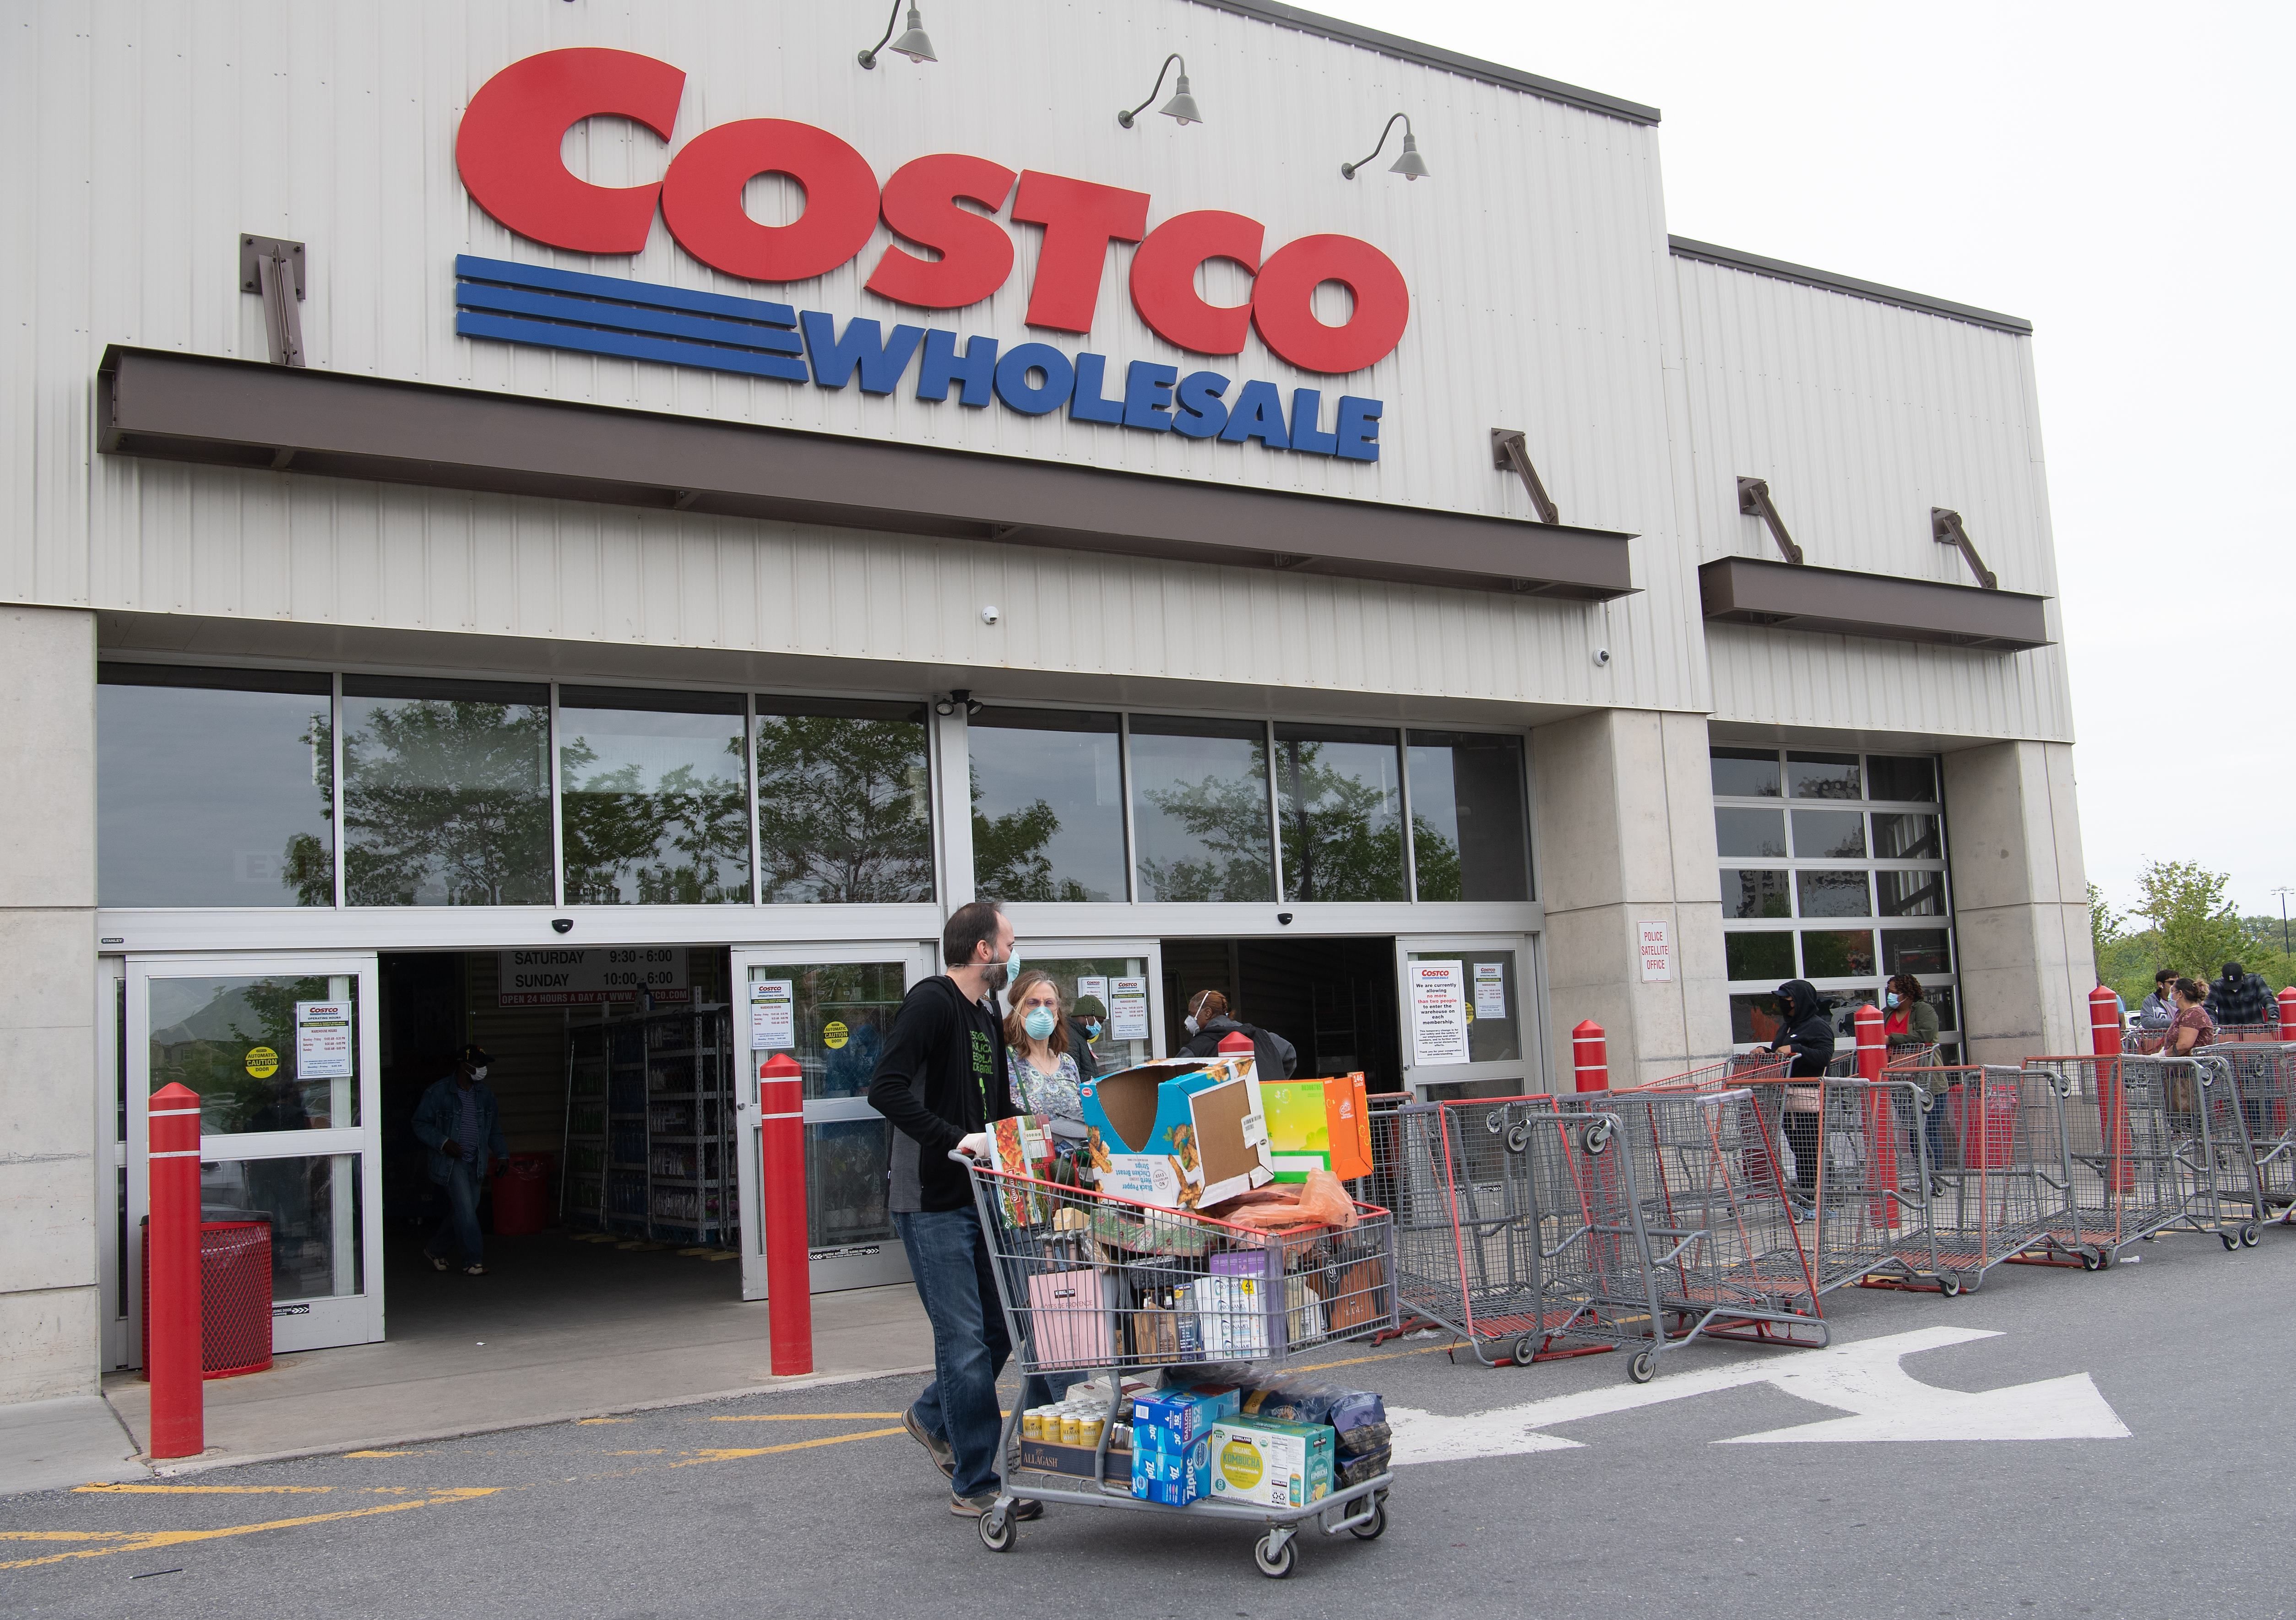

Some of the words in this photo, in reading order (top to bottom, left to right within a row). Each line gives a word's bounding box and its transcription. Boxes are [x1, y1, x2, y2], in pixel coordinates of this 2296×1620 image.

[455, 47, 1410, 374] COSTCO
[800, 310, 1384, 462] WHOLESALE
[1645, 932, 1663, 941] POLICE
[1641, 946, 1668, 955] SATELLITE
[515, 951, 585, 965] SATURDAY
[610, 950, 636, 963] 9:30
[646, 950, 672, 962] 6:00
[1647, 960, 1665, 970] OFFICE
[515, 974, 570, 988] SUNDAY
[603, 972, 637, 986] 10:00
[647, 971, 673, 984] 6:00
[502, 995, 524, 1004] OPEN
[527, 995, 537, 1003] 24
[540, 994, 567, 1002] HOURS
[579, 993, 594, 1002] DAY
[597, 992, 607, 1001] AT
[1353, 1074, 1363, 1083] 146
[1132, 1169, 1151, 1177] Chicken
[1122, 1182, 1139, 1191] Pepper
[1232, 1446, 1252, 1455] ORGANIC
[1023, 1452, 1058, 1468] ALLAGASH
[1223, 1453, 1260, 1468] KOMBUCHA
[1238, 1466, 1259, 1475] Lemonade
[1310, 1468, 1328, 1479] KOMBUCHA
[1186, 1457, 1197, 1500] Ziploc
